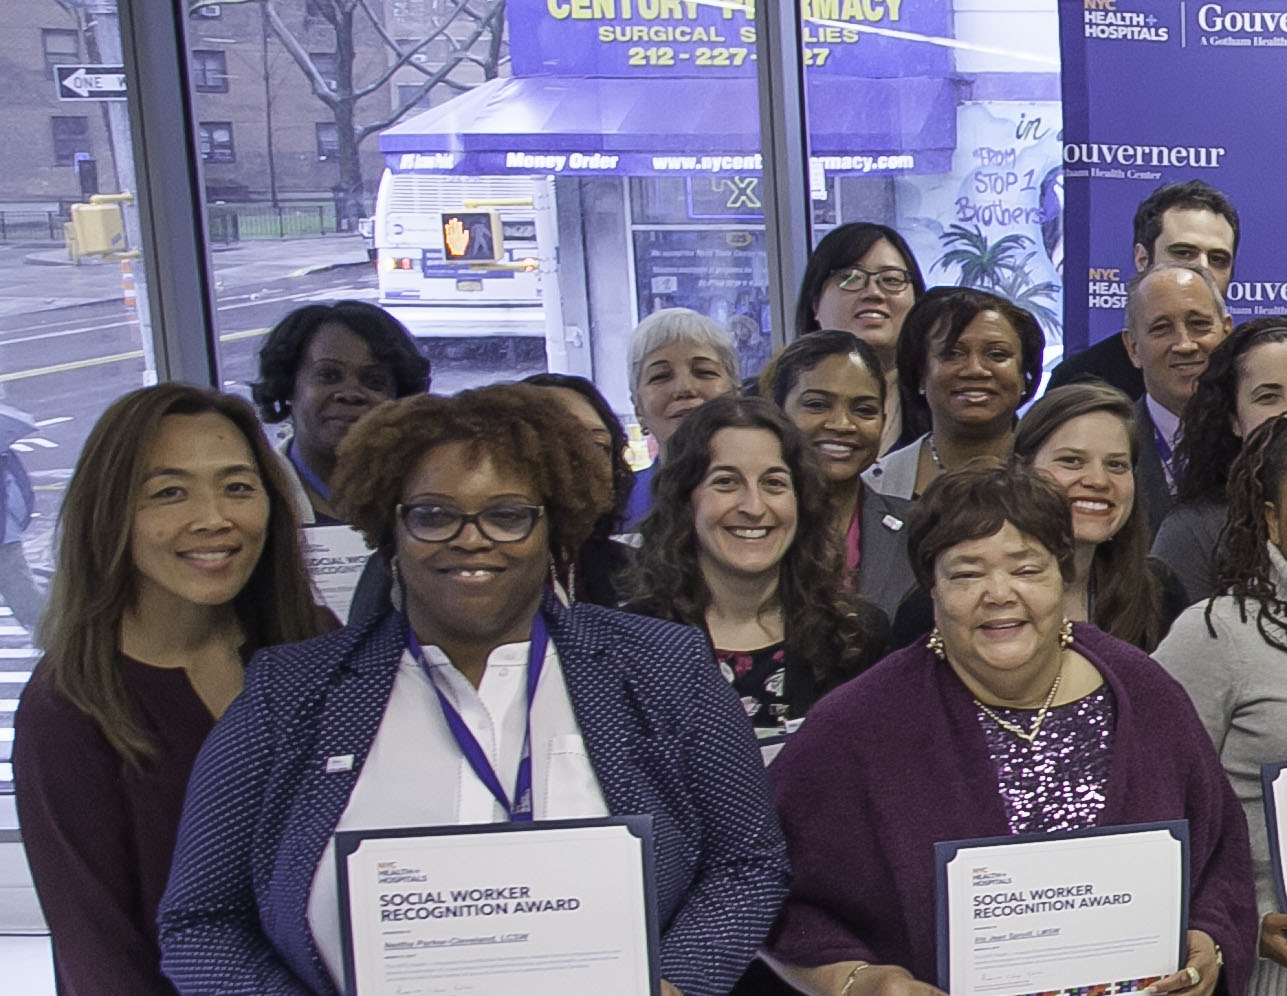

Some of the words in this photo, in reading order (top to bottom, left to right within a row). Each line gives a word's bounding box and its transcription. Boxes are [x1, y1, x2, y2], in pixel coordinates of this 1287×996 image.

[547, 0, 699, 20] CENTURY
[1083, 0, 1117, 11] NYC
[599, 26, 726, 42] SURGICAL
[1084, 27, 1169, 42] HOSPITALS
[1209, 37, 1252, 46] Gotham
[1253, 37, 1287, 47] Health
[74, 76, 103, 89] ONE
[505, 152, 567, 171] Money
[569, 153, 619, 169] Order
[1063, 143, 1225, 168] ouverneur
[1091, 168, 1125, 178] Health
[1126, 169, 1162, 180] Center
[974, 171, 1018, 195] STOP
[954, 196, 1048, 226] Brothers
[1089, 268, 1120, 281] NYC
[1089, 282, 1127, 295] HEAL
[1254, 305, 1287, 315] Health
[379, 890, 448, 907] SOCIAL
[450, 886, 530, 902] WORKER
[973, 892, 1027, 907] SOCIAL
[1030, 885, 1093, 900] WORKER
[380, 902, 508, 922] RECOGNITION
[513, 897, 580, 914] AWARD
[974, 901, 1075, 919] RECOGNITION
[1078, 894, 1132, 908] AWARD
